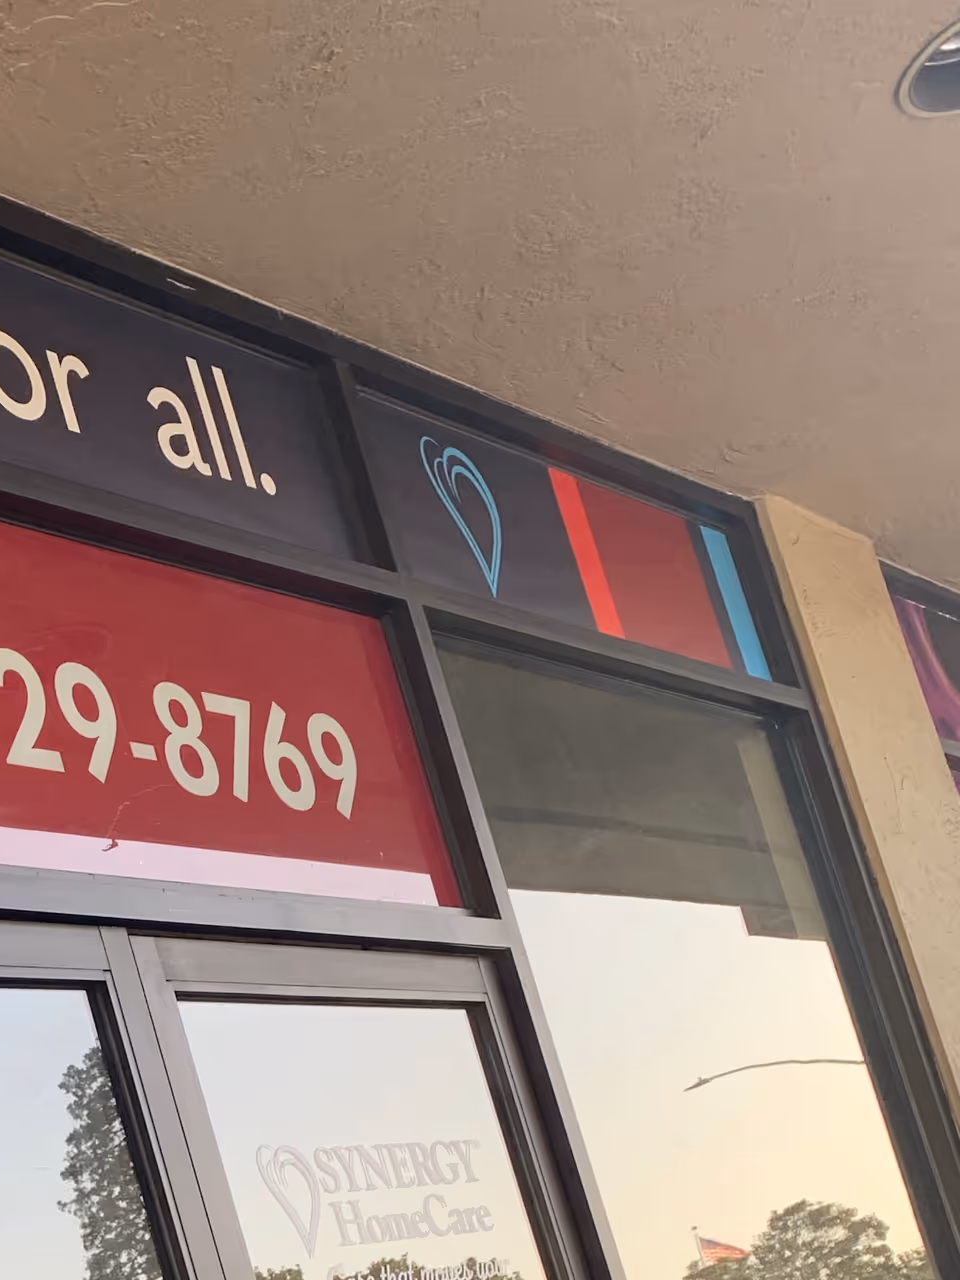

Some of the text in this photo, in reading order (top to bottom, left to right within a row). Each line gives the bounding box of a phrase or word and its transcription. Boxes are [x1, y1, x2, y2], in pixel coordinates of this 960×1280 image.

[146, 356, 278, 497] all.
[313, 1139, 480, 1194] SYNERGY
[328, 1193, 495, 1247] HomeCare
